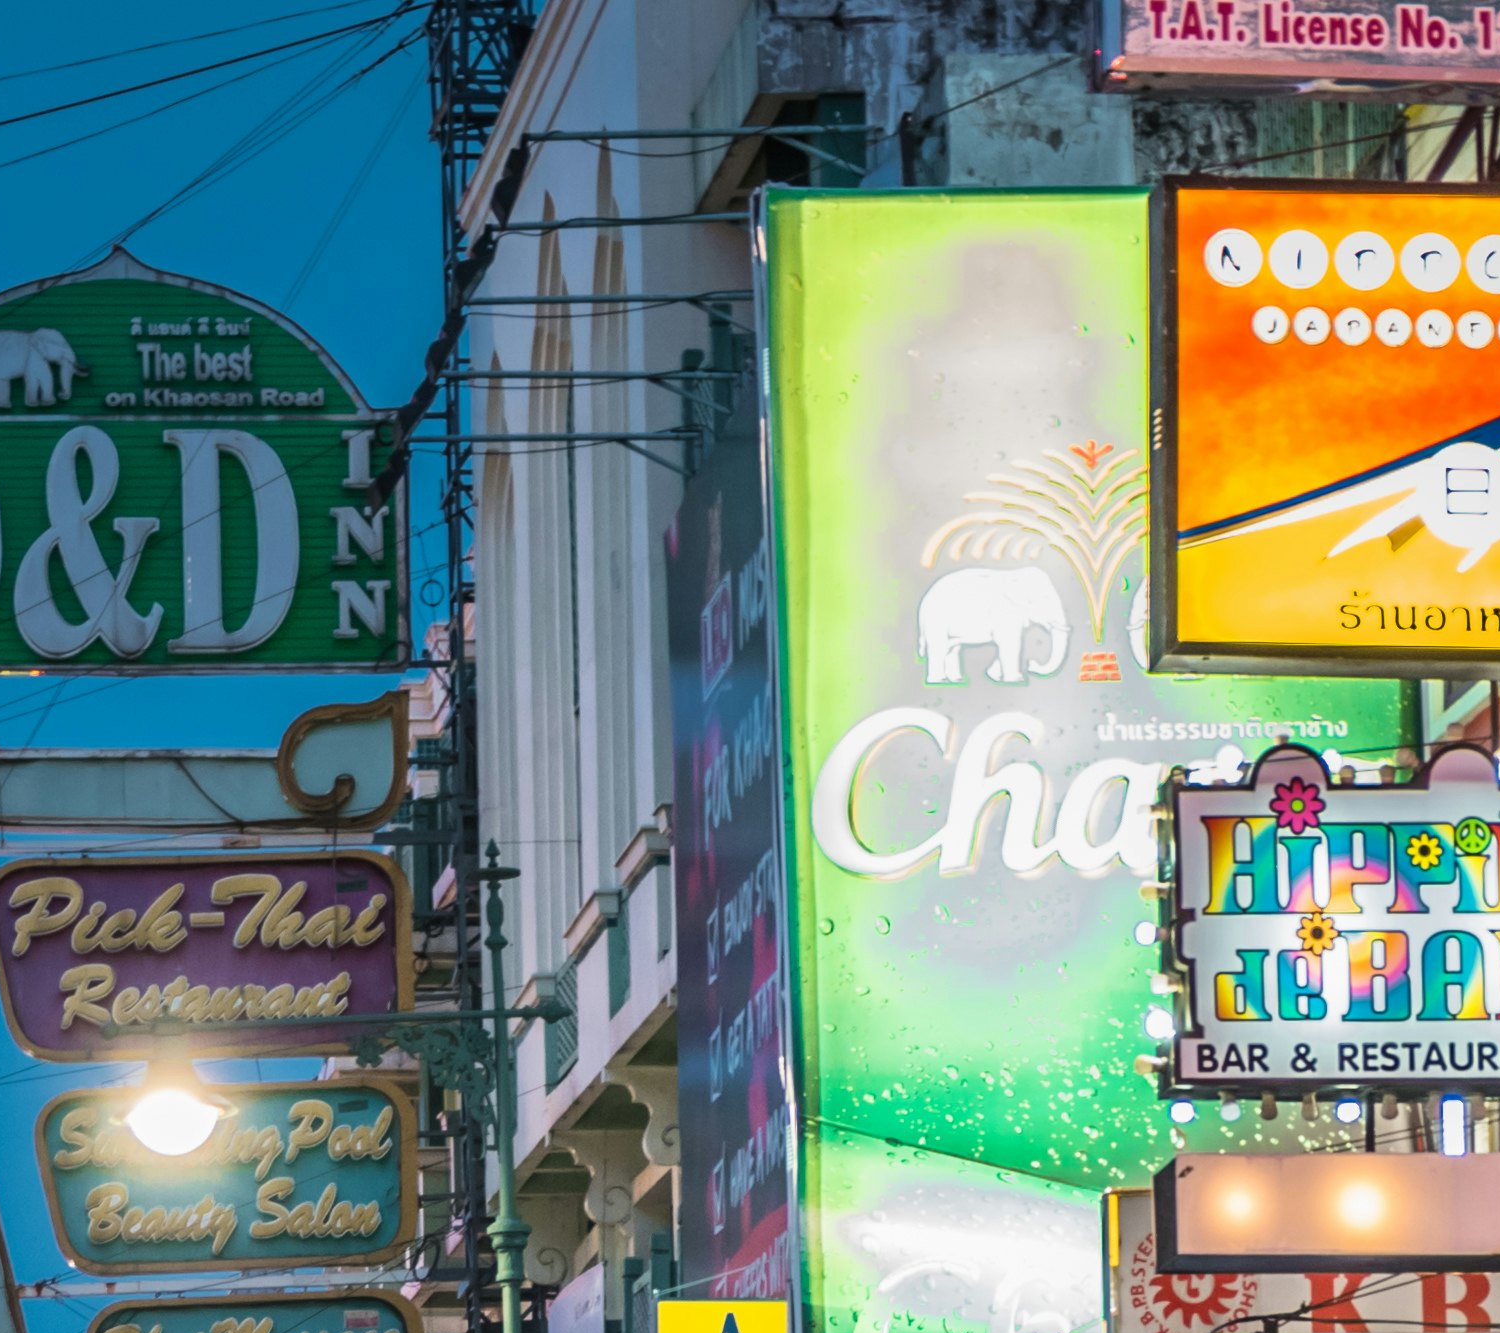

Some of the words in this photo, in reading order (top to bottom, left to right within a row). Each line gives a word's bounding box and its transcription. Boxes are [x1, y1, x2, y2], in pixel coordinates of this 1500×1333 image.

[1149, 0, 1246, 41] T.A.T.
[1262, 2, 1385, 47] License
[1402, 10, 1459, 49] No.
[136, 342, 187, 382] The
[194, 342, 254, 382] best
[105, 391, 137, 407] on
[143, 387, 254, 407] Khaosan
[260, 387, 325, 407] Road
[329, 428, 391, 639] INN
[8, 872, 389, 956] Pick-Thai
[59, 962, 351, 1031] Restaurant
[1196, 1043, 1270, 1073] BAR
[1290, 1043, 1319, 1073] &
[286, 1099, 392, 1163] Pool
[86, 1182, 239, 1256] Beauty
[249, 1177, 383, 1242] Salon
